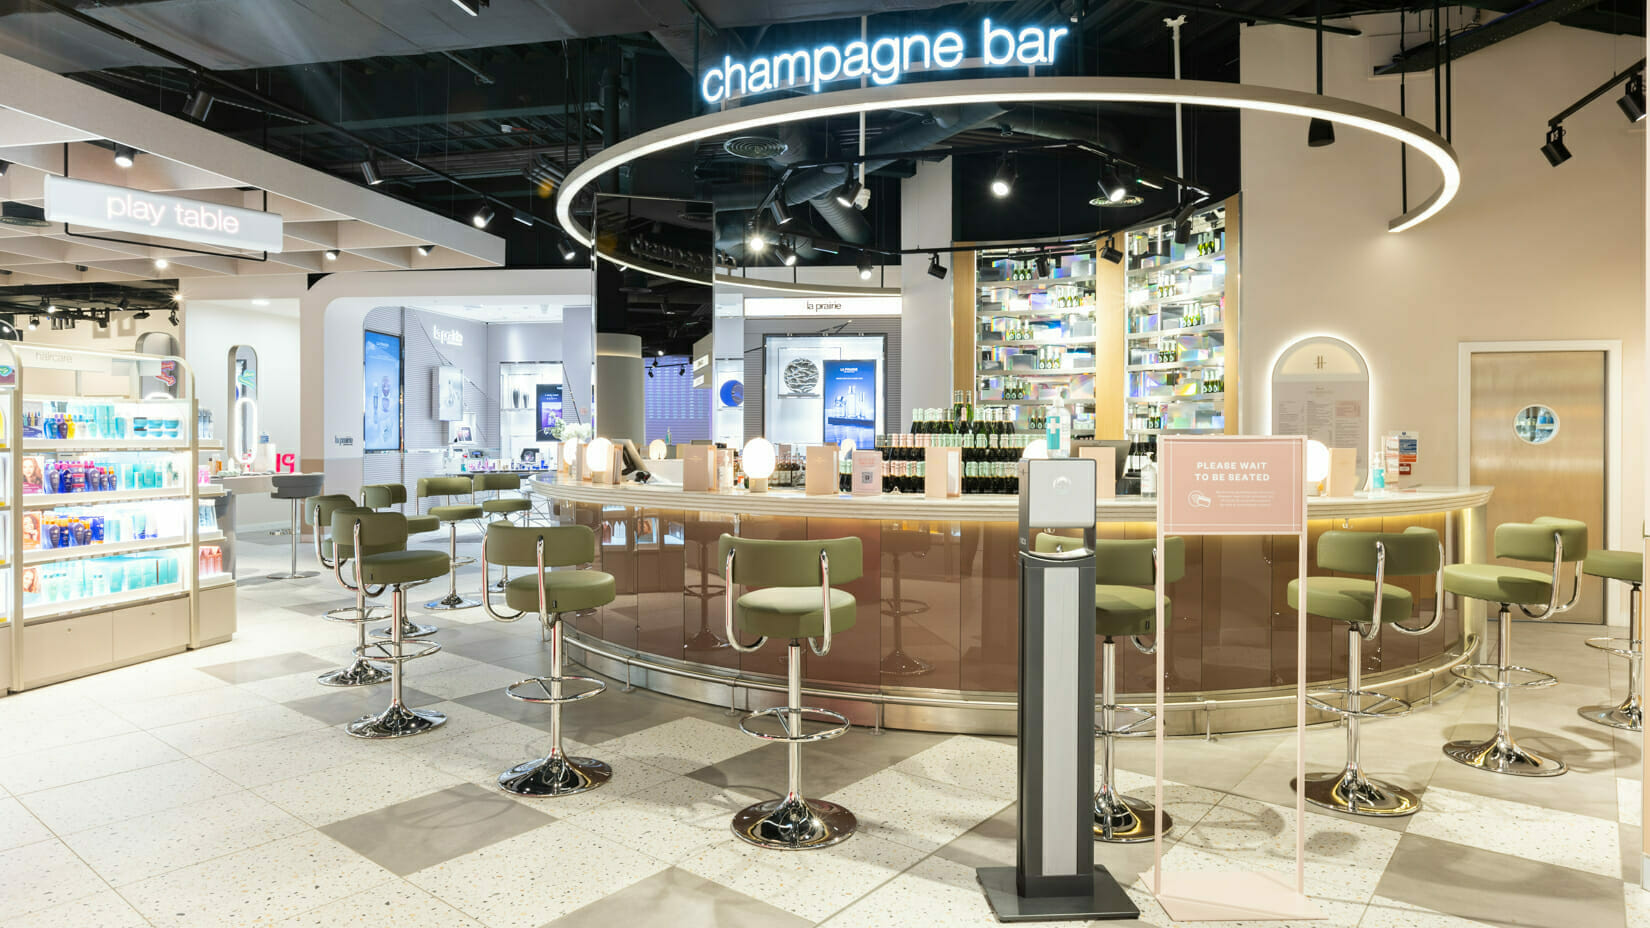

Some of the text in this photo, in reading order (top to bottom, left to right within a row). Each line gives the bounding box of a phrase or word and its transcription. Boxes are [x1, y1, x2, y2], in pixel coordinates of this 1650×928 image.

[702, 18, 1068, 102] champagne bar
[107, 194, 239, 234] play table
[807, 300, 841, 312] la prairie
[1196, 461, 1268, 470] PLEASE WAIT
[1194, 472, 1270, 481] TO BE SEATED
